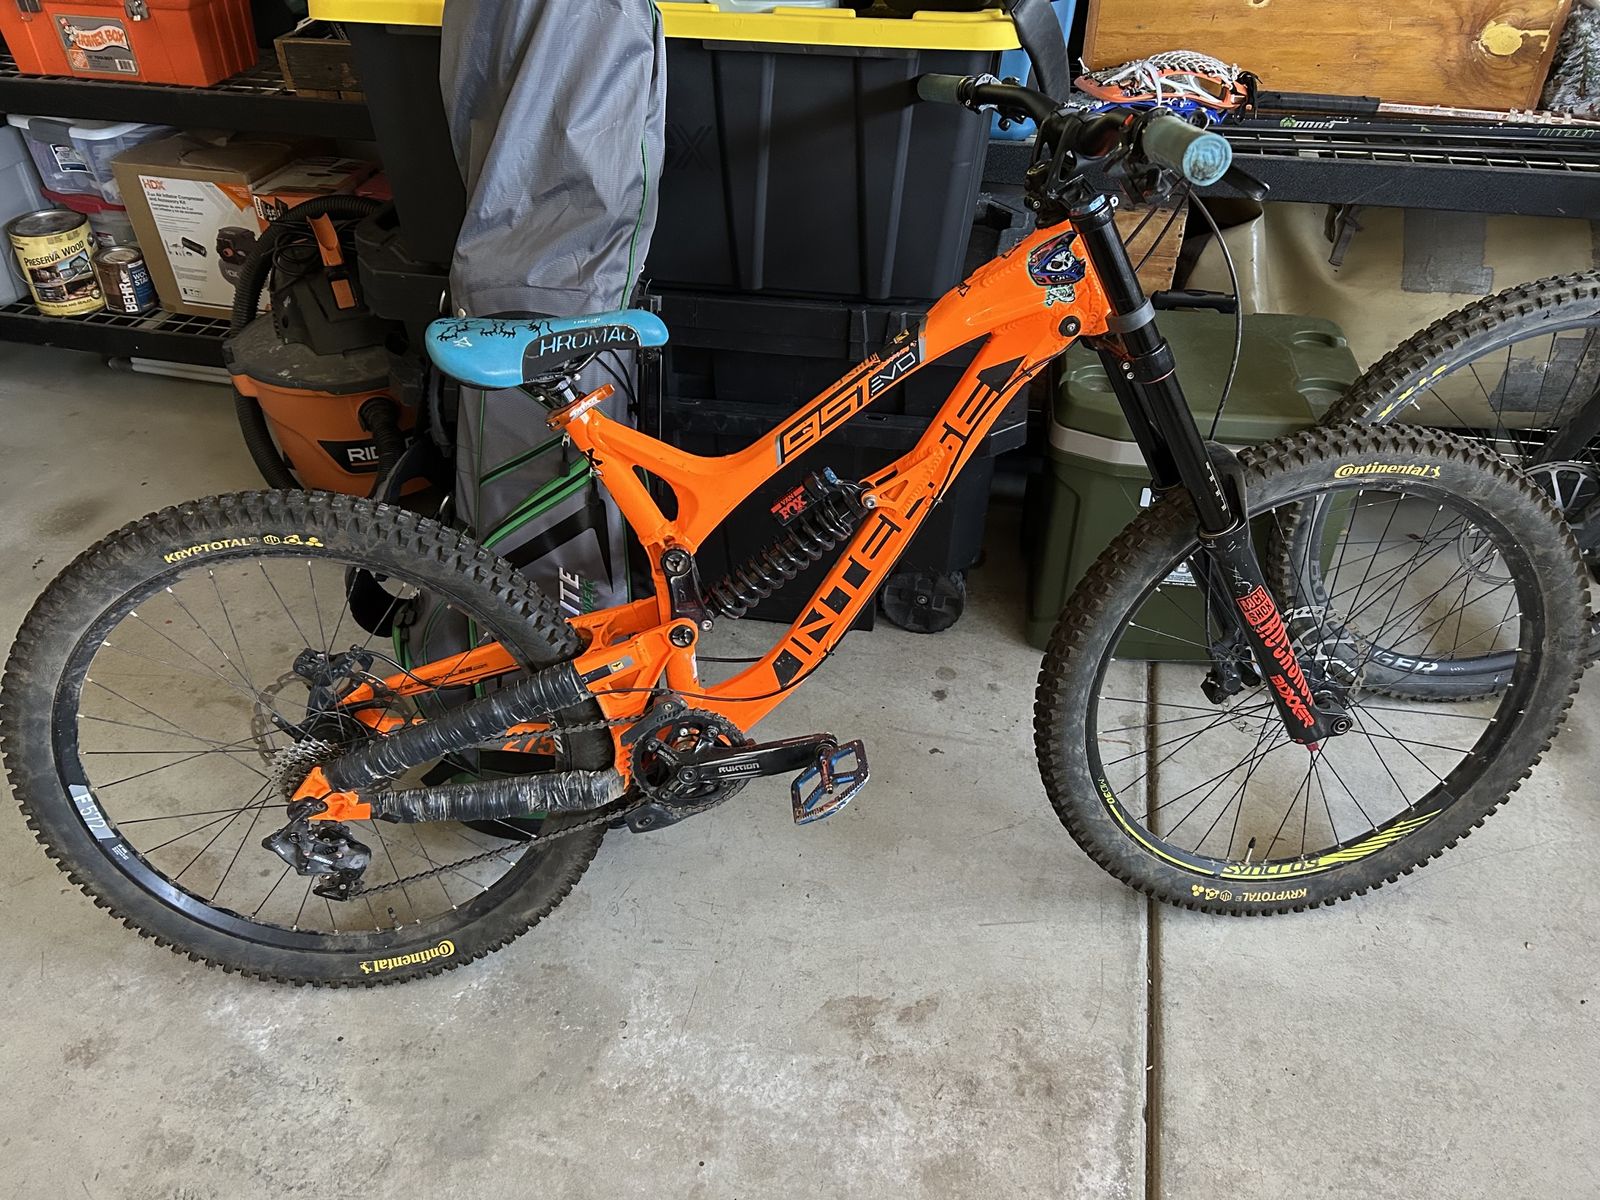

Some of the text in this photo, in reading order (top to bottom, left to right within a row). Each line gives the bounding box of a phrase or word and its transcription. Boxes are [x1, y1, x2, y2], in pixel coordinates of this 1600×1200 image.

[105, 29, 124, 44] BOX
[142, 178, 166, 190] HDX
[24, 240, 85, 267] PRESERVA WOOD
[119, 281, 139, 313] BEHR
[871, 350, 916, 397] EVO
[1334, 461, 1430, 479] Continental
[779, 495, 808, 520] FOX
[164, 537, 250, 564] KRYPTOTAL
[1240, 590, 1267, 612] ROCK
[1243, 886, 1307, 902] KRYPTOTAL
[374, 939, 456, 973] Continental
